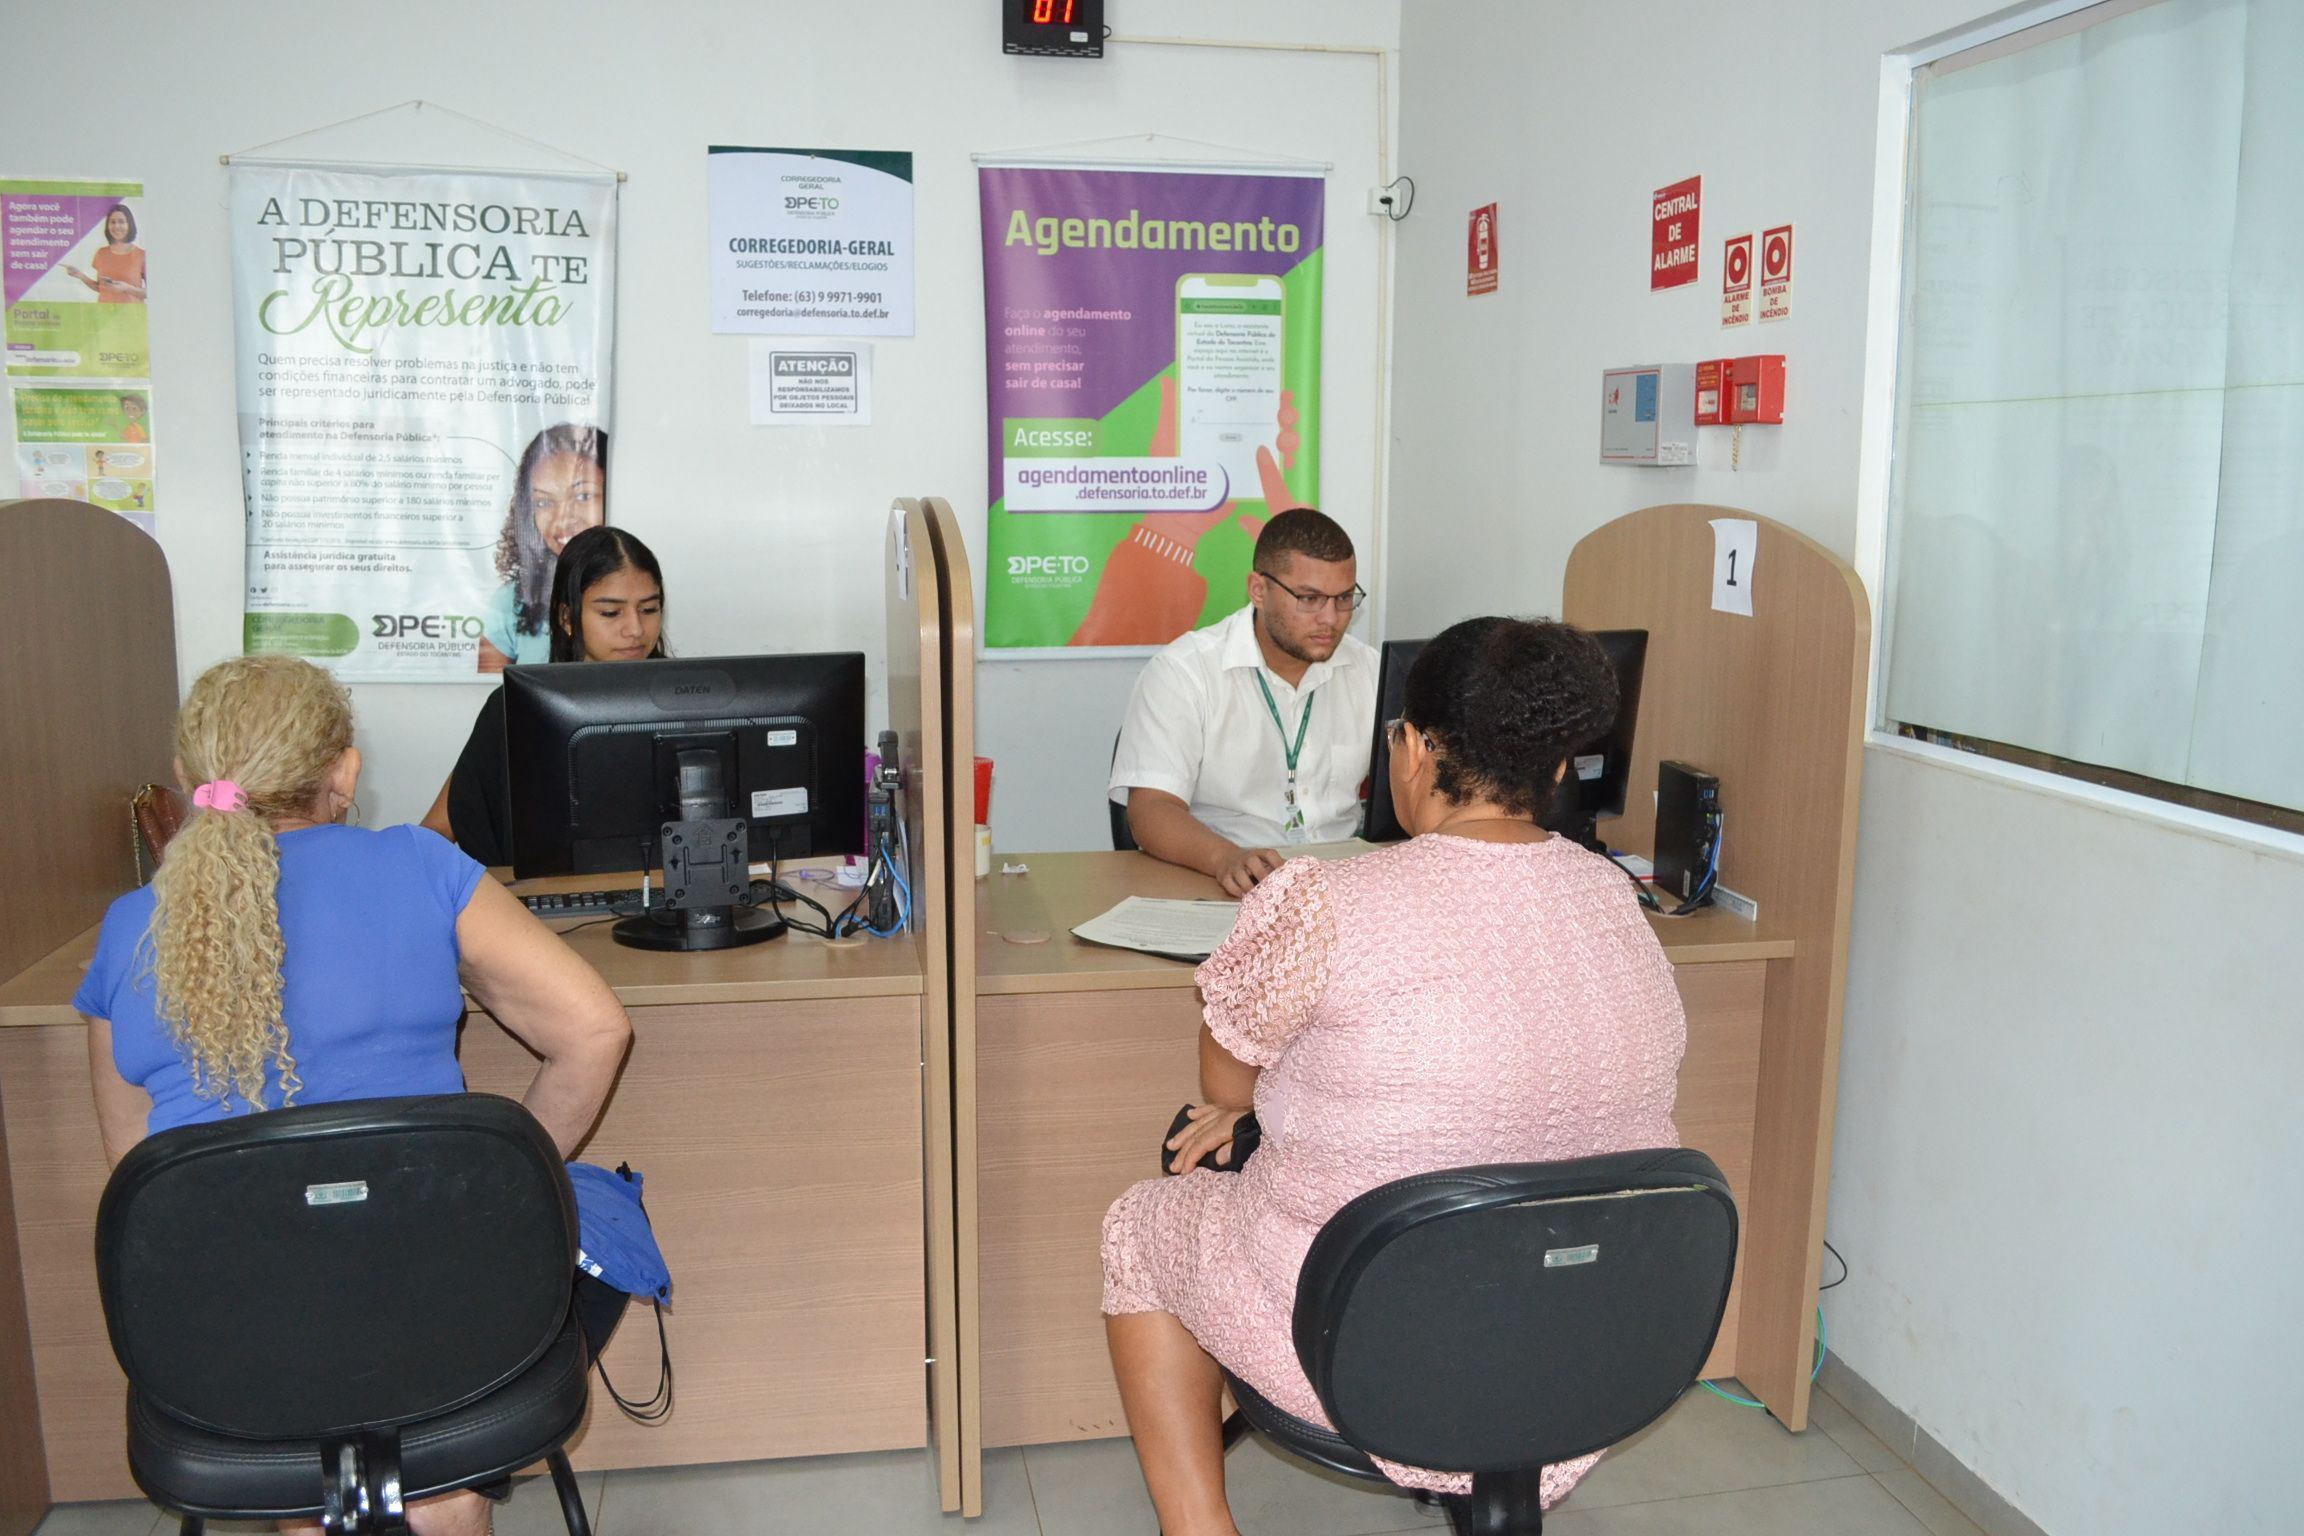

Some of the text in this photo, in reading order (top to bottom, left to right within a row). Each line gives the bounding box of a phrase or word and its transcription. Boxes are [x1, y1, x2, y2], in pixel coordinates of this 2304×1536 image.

[780, 175, 842, 184] CORREGEDORIA
[9, 202, 60, 212] Agora você
[1654, 192, 1698, 221] CENTRAL
[9, 214, 74, 224] também pode
[257, 197, 590, 238] A DEFENSORIA
[9, 226, 48, 236] agendar
[1004, 209, 1301, 256] Agendamento
[1668, 222, 1682, 242] DE
[10, 238, 70, 247] atendimento
[729, 238, 895, 256] CORREGEDORIA-GERAL
[32, 250, 48, 258] sair
[272, 228, 588, 284] PÚBLICA TE
[1654, 244, 1696, 271] ALARME
[11, 261, 48, 270] de casa!
[736, 258, 889, 273] SUGESTÕES/RECLAMAÇÕES/ELOGIOS
[742, 289, 883, 305] Telefone: (63) 9 9971-9901
[1763, 285, 1787, 297] BOMBA
[1723, 292, 1749, 304] ALARME
[1769, 297, 1778, 306] DE
[14, 309, 49, 320] Portal
[258, 272, 574, 355] Representa
[737, 307, 889, 320] corregedoria@defensoria.to.def.br
[1004, 307, 1132, 321] Faça o agendamento
[1731, 304, 1740, 313] DE
[1760, 307, 1788, 319] INCÊNDIO
[1722, 313, 1749, 326] INCÊNDIO
[1004, 325, 1086, 337] online do seu
[1004, 343, 1082, 356] atendimento,
[258, 353, 579, 375] Quem precisa resolver problemas na justiça e não tem
[778, 357, 850, 375] ATENÇÃO
[1005, 360, 1085, 373] sem precisar
[258, 370, 596, 391] condições financeiras para contratar um advogado, pode
[798, 377, 813, 385] NÃO
[1005, 376, 1082, 389] sair de casa!
[259, 388, 276, 397] ser
[281, 387, 360, 401] representado
[363, 388, 447, 401] juridicamente
[450, 391, 474, 403] pela
[477, 391, 541, 404] Defensoria
[259, 418, 309, 428] Principais
[352, 421, 375, 430] para
[259, 430, 323, 440] atendimento
[326, 432, 338, 440] na
[340, 432, 394, 441] Defensoria
[1013, 427, 1093, 448] Acesse:
[1018, 465, 1208, 488] agendamentoonline
[1075, 486, 1208, 499] .defensoria.to.def.br
[264, 551, 396, 562] Assistência jurídica gratuita
[264, 562, 413, 573] para assegurar os seus direitos.
[1726, 549, 1737, 586] 1
[378, 641, 477, 651] DEFENSORIA PÚBLICA
[674, 686, 711, 696] DATEN
